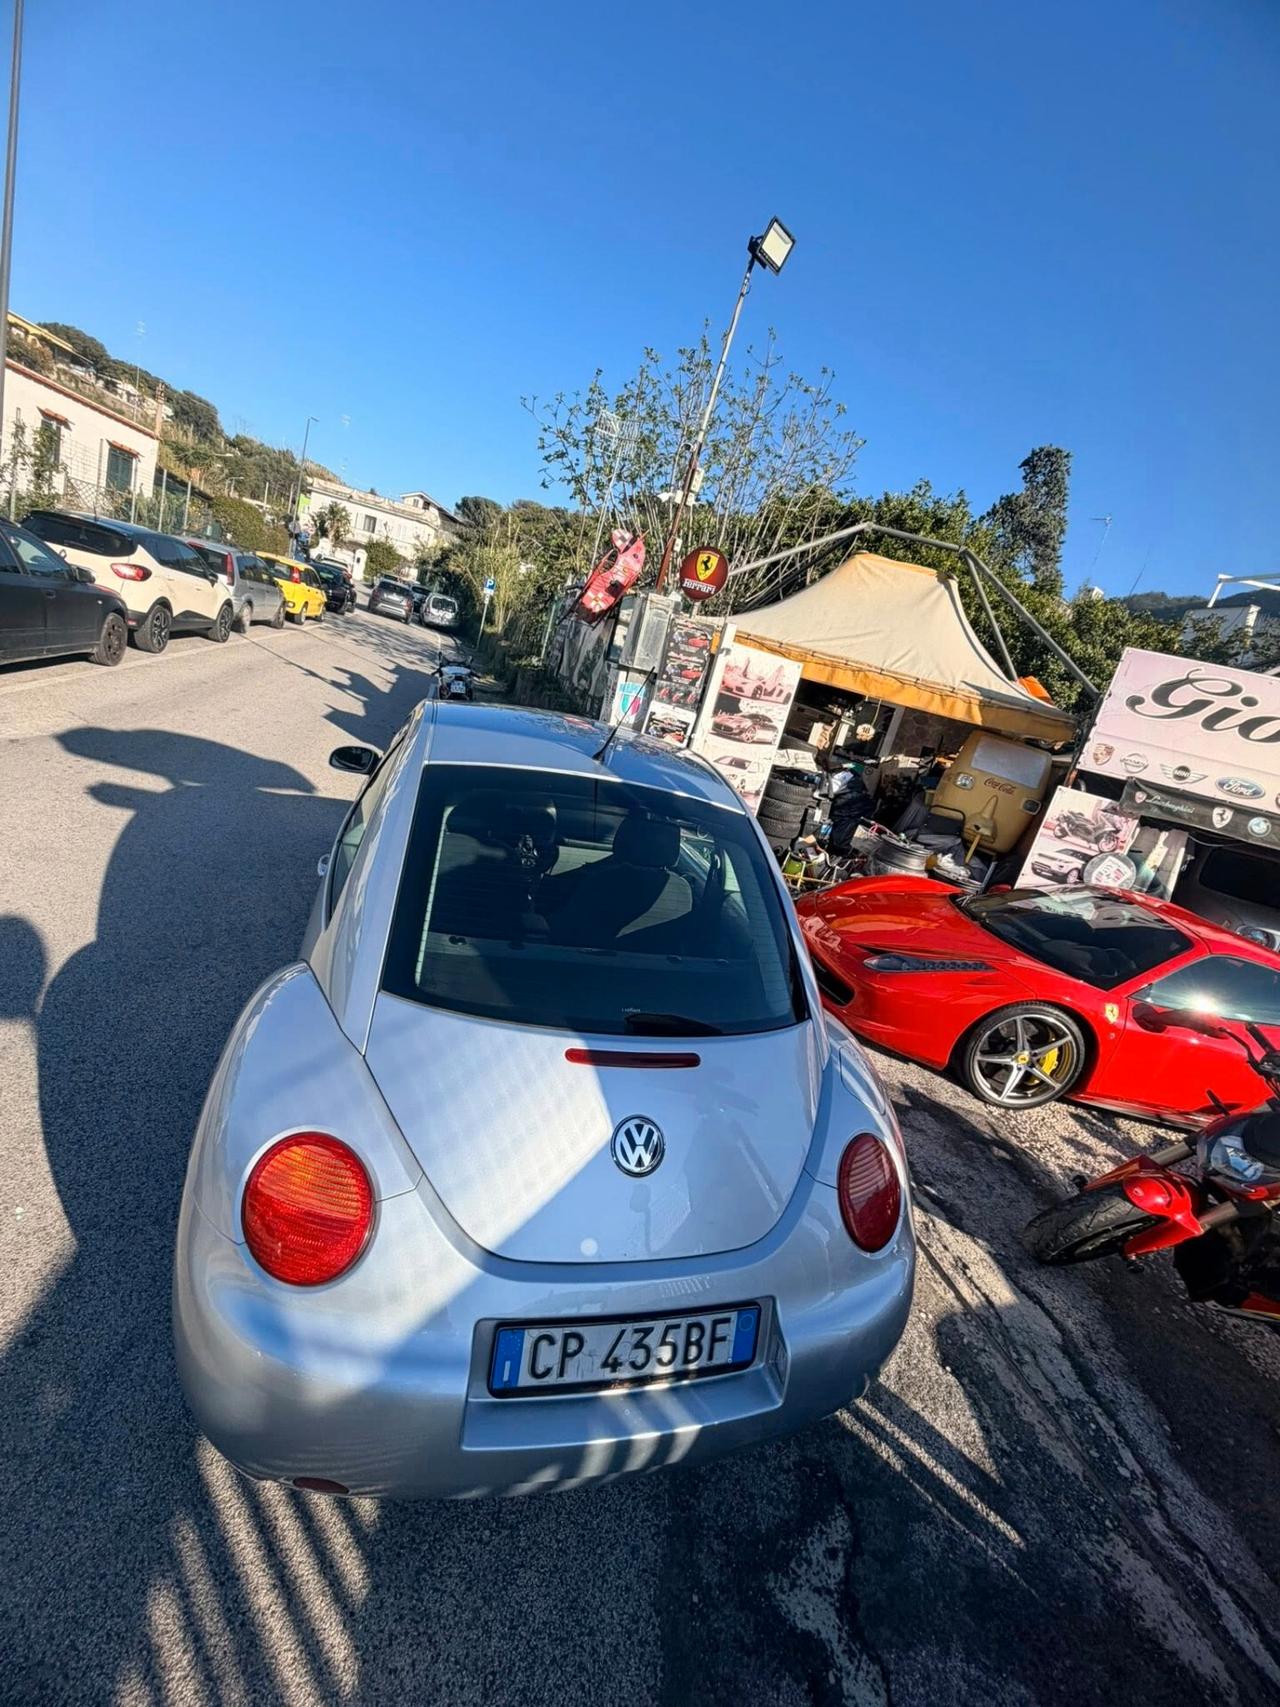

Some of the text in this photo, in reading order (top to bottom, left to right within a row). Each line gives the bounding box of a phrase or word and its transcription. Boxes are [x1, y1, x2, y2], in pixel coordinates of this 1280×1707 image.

[682, 578, 717, 594] Ferrari
[1223, 780, 1257, 796] Ford
[531, 1317, 732, 1379] CP 435BF
